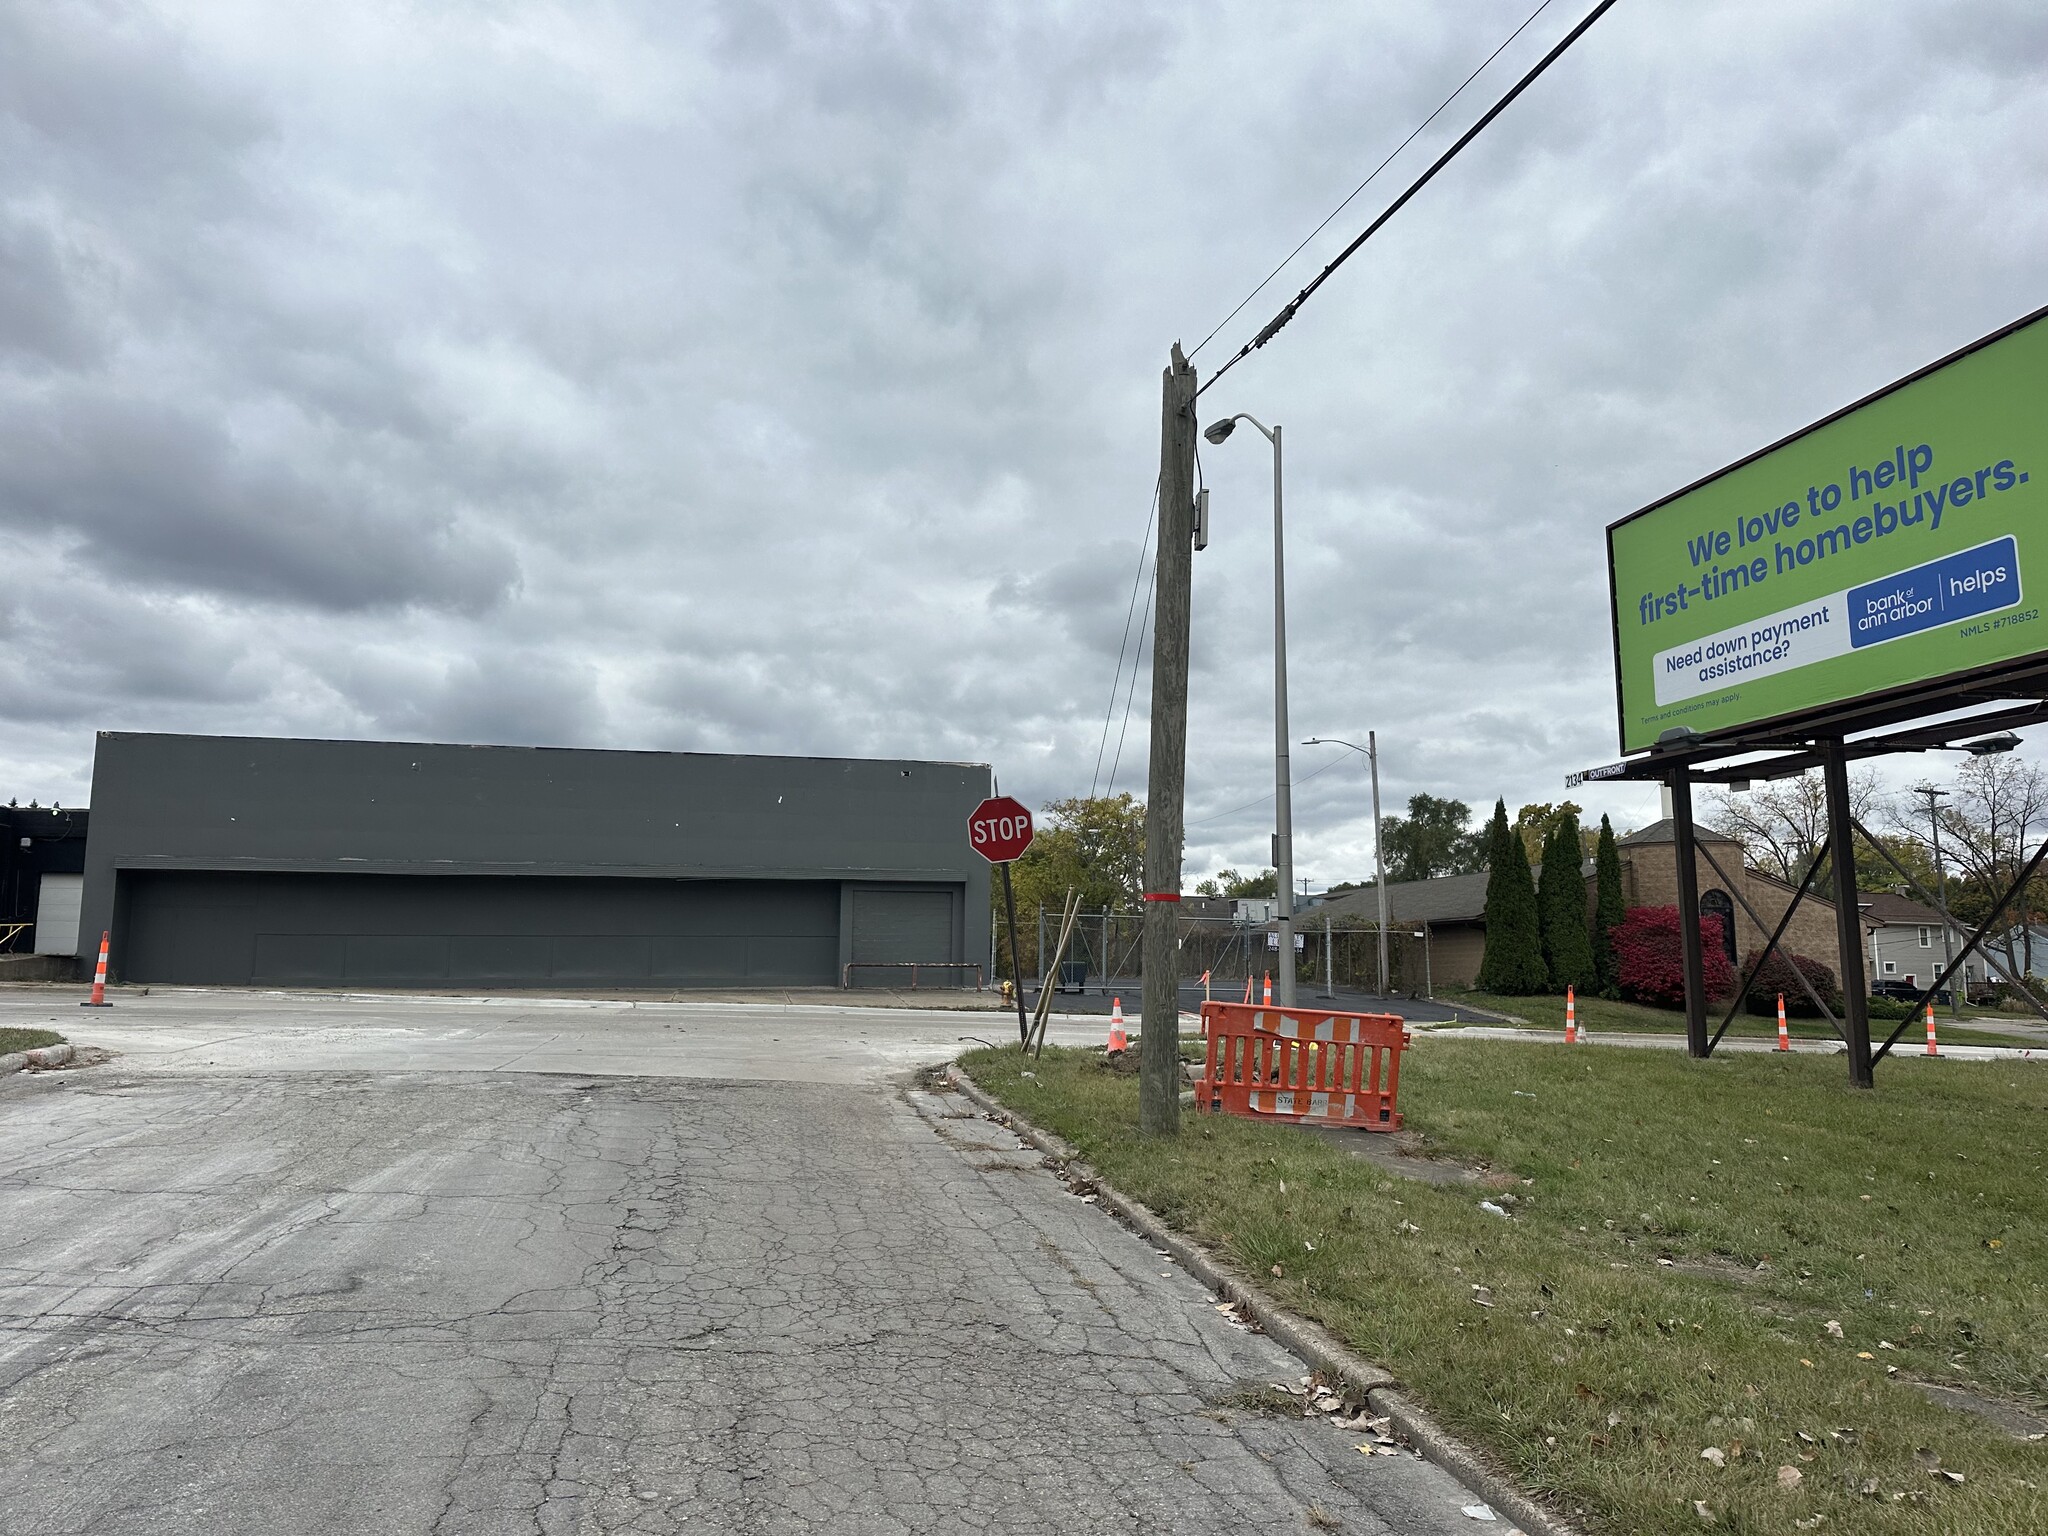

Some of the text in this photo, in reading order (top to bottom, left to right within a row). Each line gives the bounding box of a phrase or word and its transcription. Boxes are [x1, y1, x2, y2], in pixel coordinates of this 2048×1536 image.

[1687, 444, 1933, 567] We love to help
[1639, 460, 2029, 626] first-time homebuyers.
[1950, 566, 2007, 597] helps
[1858, 597, 1933, 631] ann arbor
[1866, 587, 1915, 614] bank of
[1960, 609, 2039, 638] NMLS #718852
[1666, 606, 1830, 673] Need down payment
[1699, 639, 1790, 682] assistance?
[1641, 715, 1659, 725] Terms
[1660, 710, 1671, 720] and
[1672, 702, 1705, 717] conditions
[1705, 699, 1719, 709] may
[1565, 763, 1625, 788] 2134 OUTFRONT
[974, 815, 1028, 844] STOP
[1277, 1096, 1302, 1106] STATE
